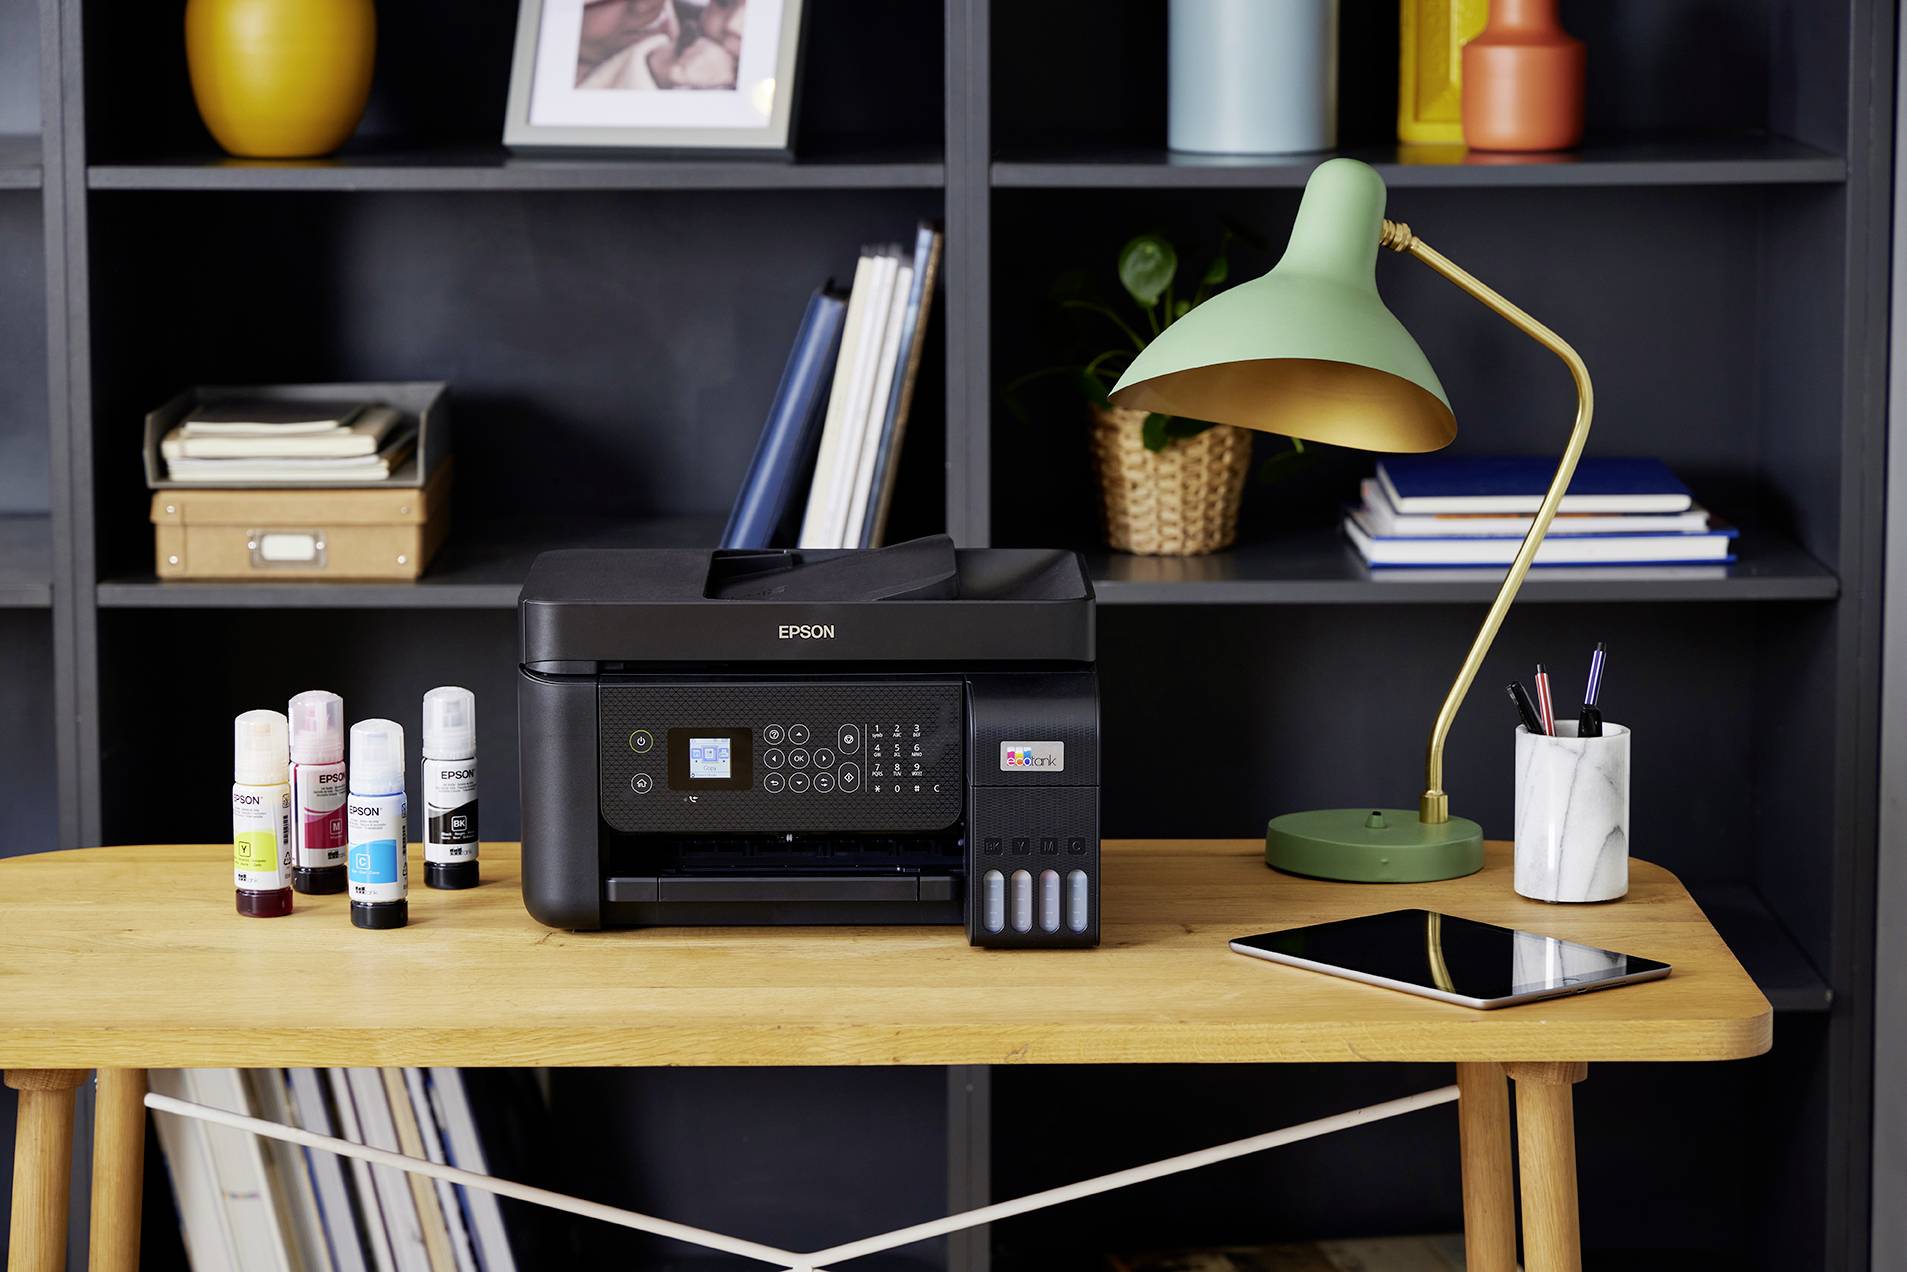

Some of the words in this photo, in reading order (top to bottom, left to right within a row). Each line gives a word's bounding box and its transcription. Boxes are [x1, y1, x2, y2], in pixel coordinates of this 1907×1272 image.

[778, 624, 835, 639] EPSON
[874, 724, 879, 732] 1
[894, 724, 900, 732] 2
[914, 724, 920, 732] 3
[894, 743, 900, 752] 5
[913, 743, 920, 752] 6
[793, 755, 805, 763] OK
[874, 763, 880, 771] 7
[894, 763, 900, 771] 8
[913, 763, 920, 771] 9
[440, 768, 474, 780] EPSON
[894, 784, 901, 793] 0
[933, 784, 940, 793] C
[332, 823, 341, 832] M
[453, 819, 466, 828] BK
[241, 845, 247, 854] Y
[359, 856, 367, 867] C
